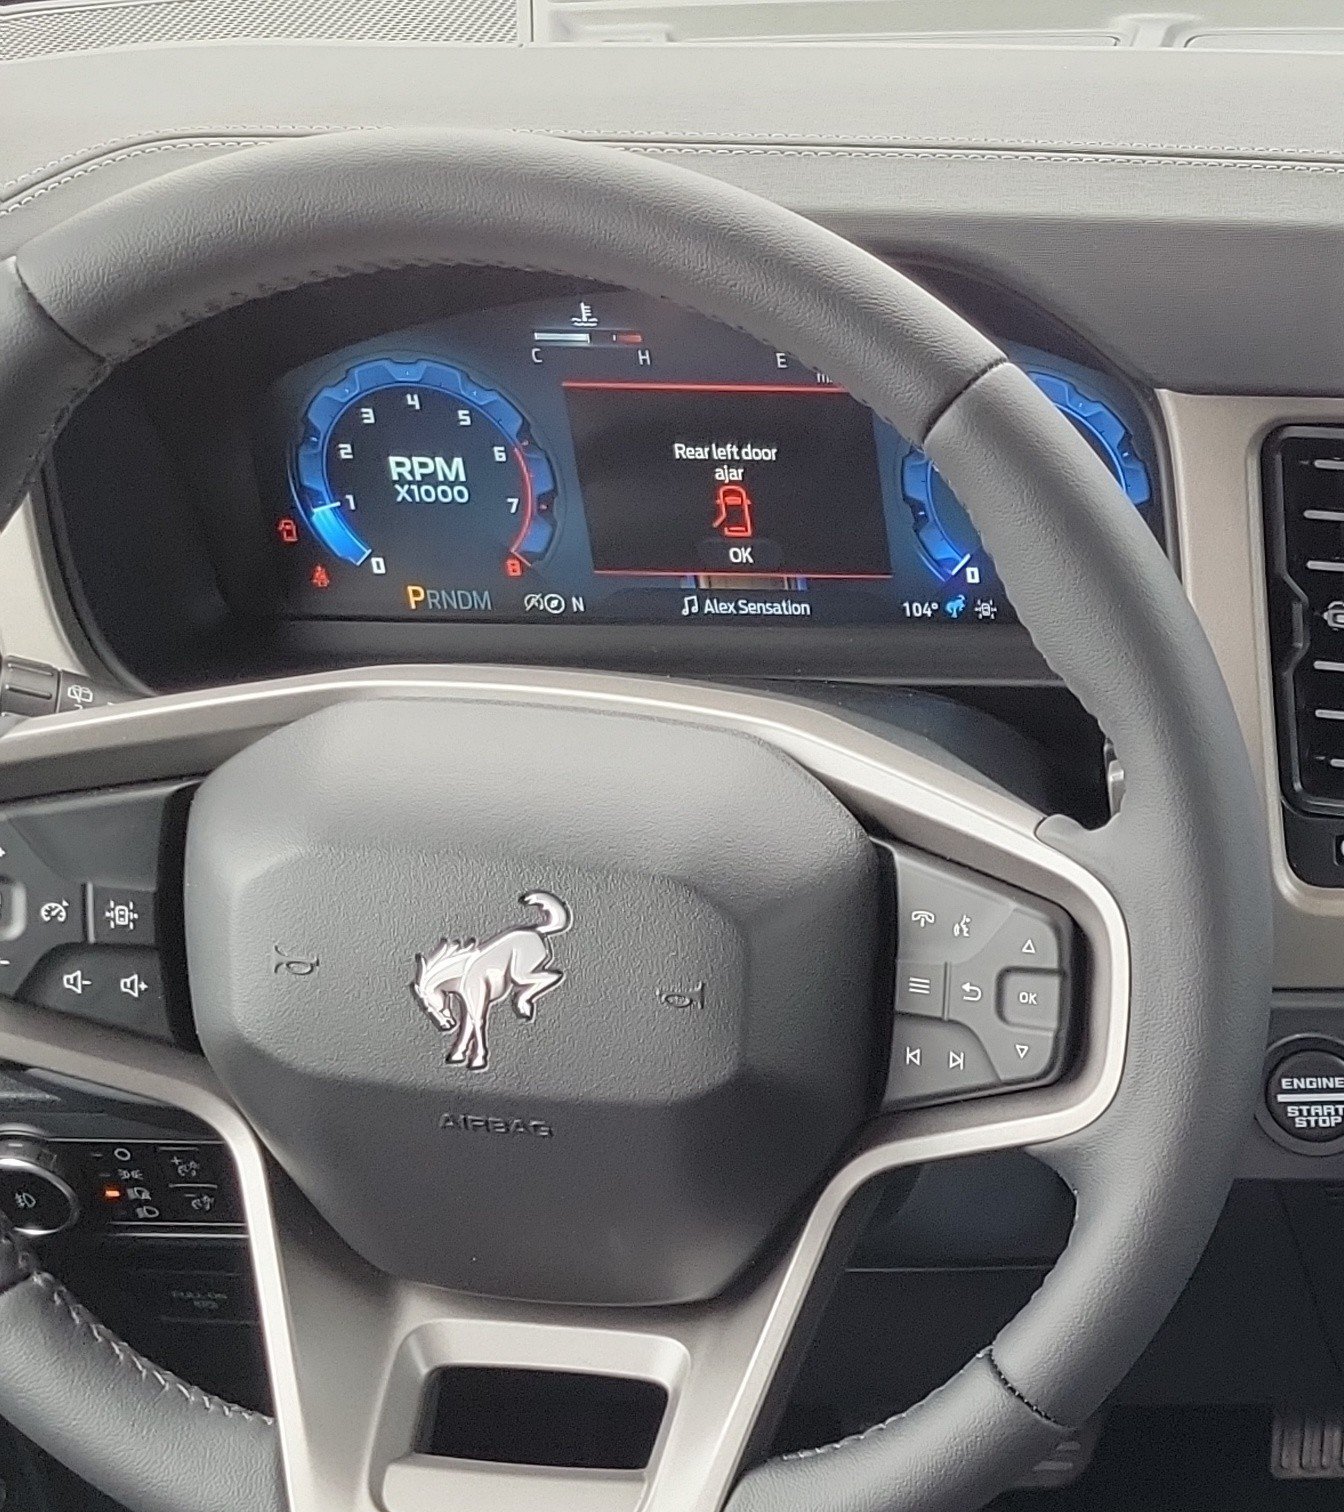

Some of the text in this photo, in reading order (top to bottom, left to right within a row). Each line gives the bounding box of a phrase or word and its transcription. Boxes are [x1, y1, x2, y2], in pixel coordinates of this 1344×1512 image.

[531, 348, 543, 363] C
[638, 350, 650, 366] H
[776, 352, 788, 369] E
[406, 393, 421, 410] 4
[360, 408, 376, 424] 3
[457, 409, 472, 426] 5
[338, 444, 354, 460] 2
[493, 447, 507, 463] 6
[673, 443, 778, 461] Rear left door
[388, 455, 467, 483] RPM
[714, 465, 744, 482] ajar
[346, 494, 356, 511] 1
[395, 484, 470, 504] X1000
[507, 498, 520, 514] 7
[728, 546, 754, 565] OK
[370, 557, 387, 575] 0
[505, 558, 523, 577] 8
[966, 566, 981, 584] 0
[571, 596, 586, 613] N
[703, 598, 811, 616] Alex Sensation
[902, 601, 939, 619] 104°
[1018, 991, 1038, 1006] OK
[438, 1113, 555, 1138] AIRBAG
[1294, 1116, 1343, 1128] STOP
